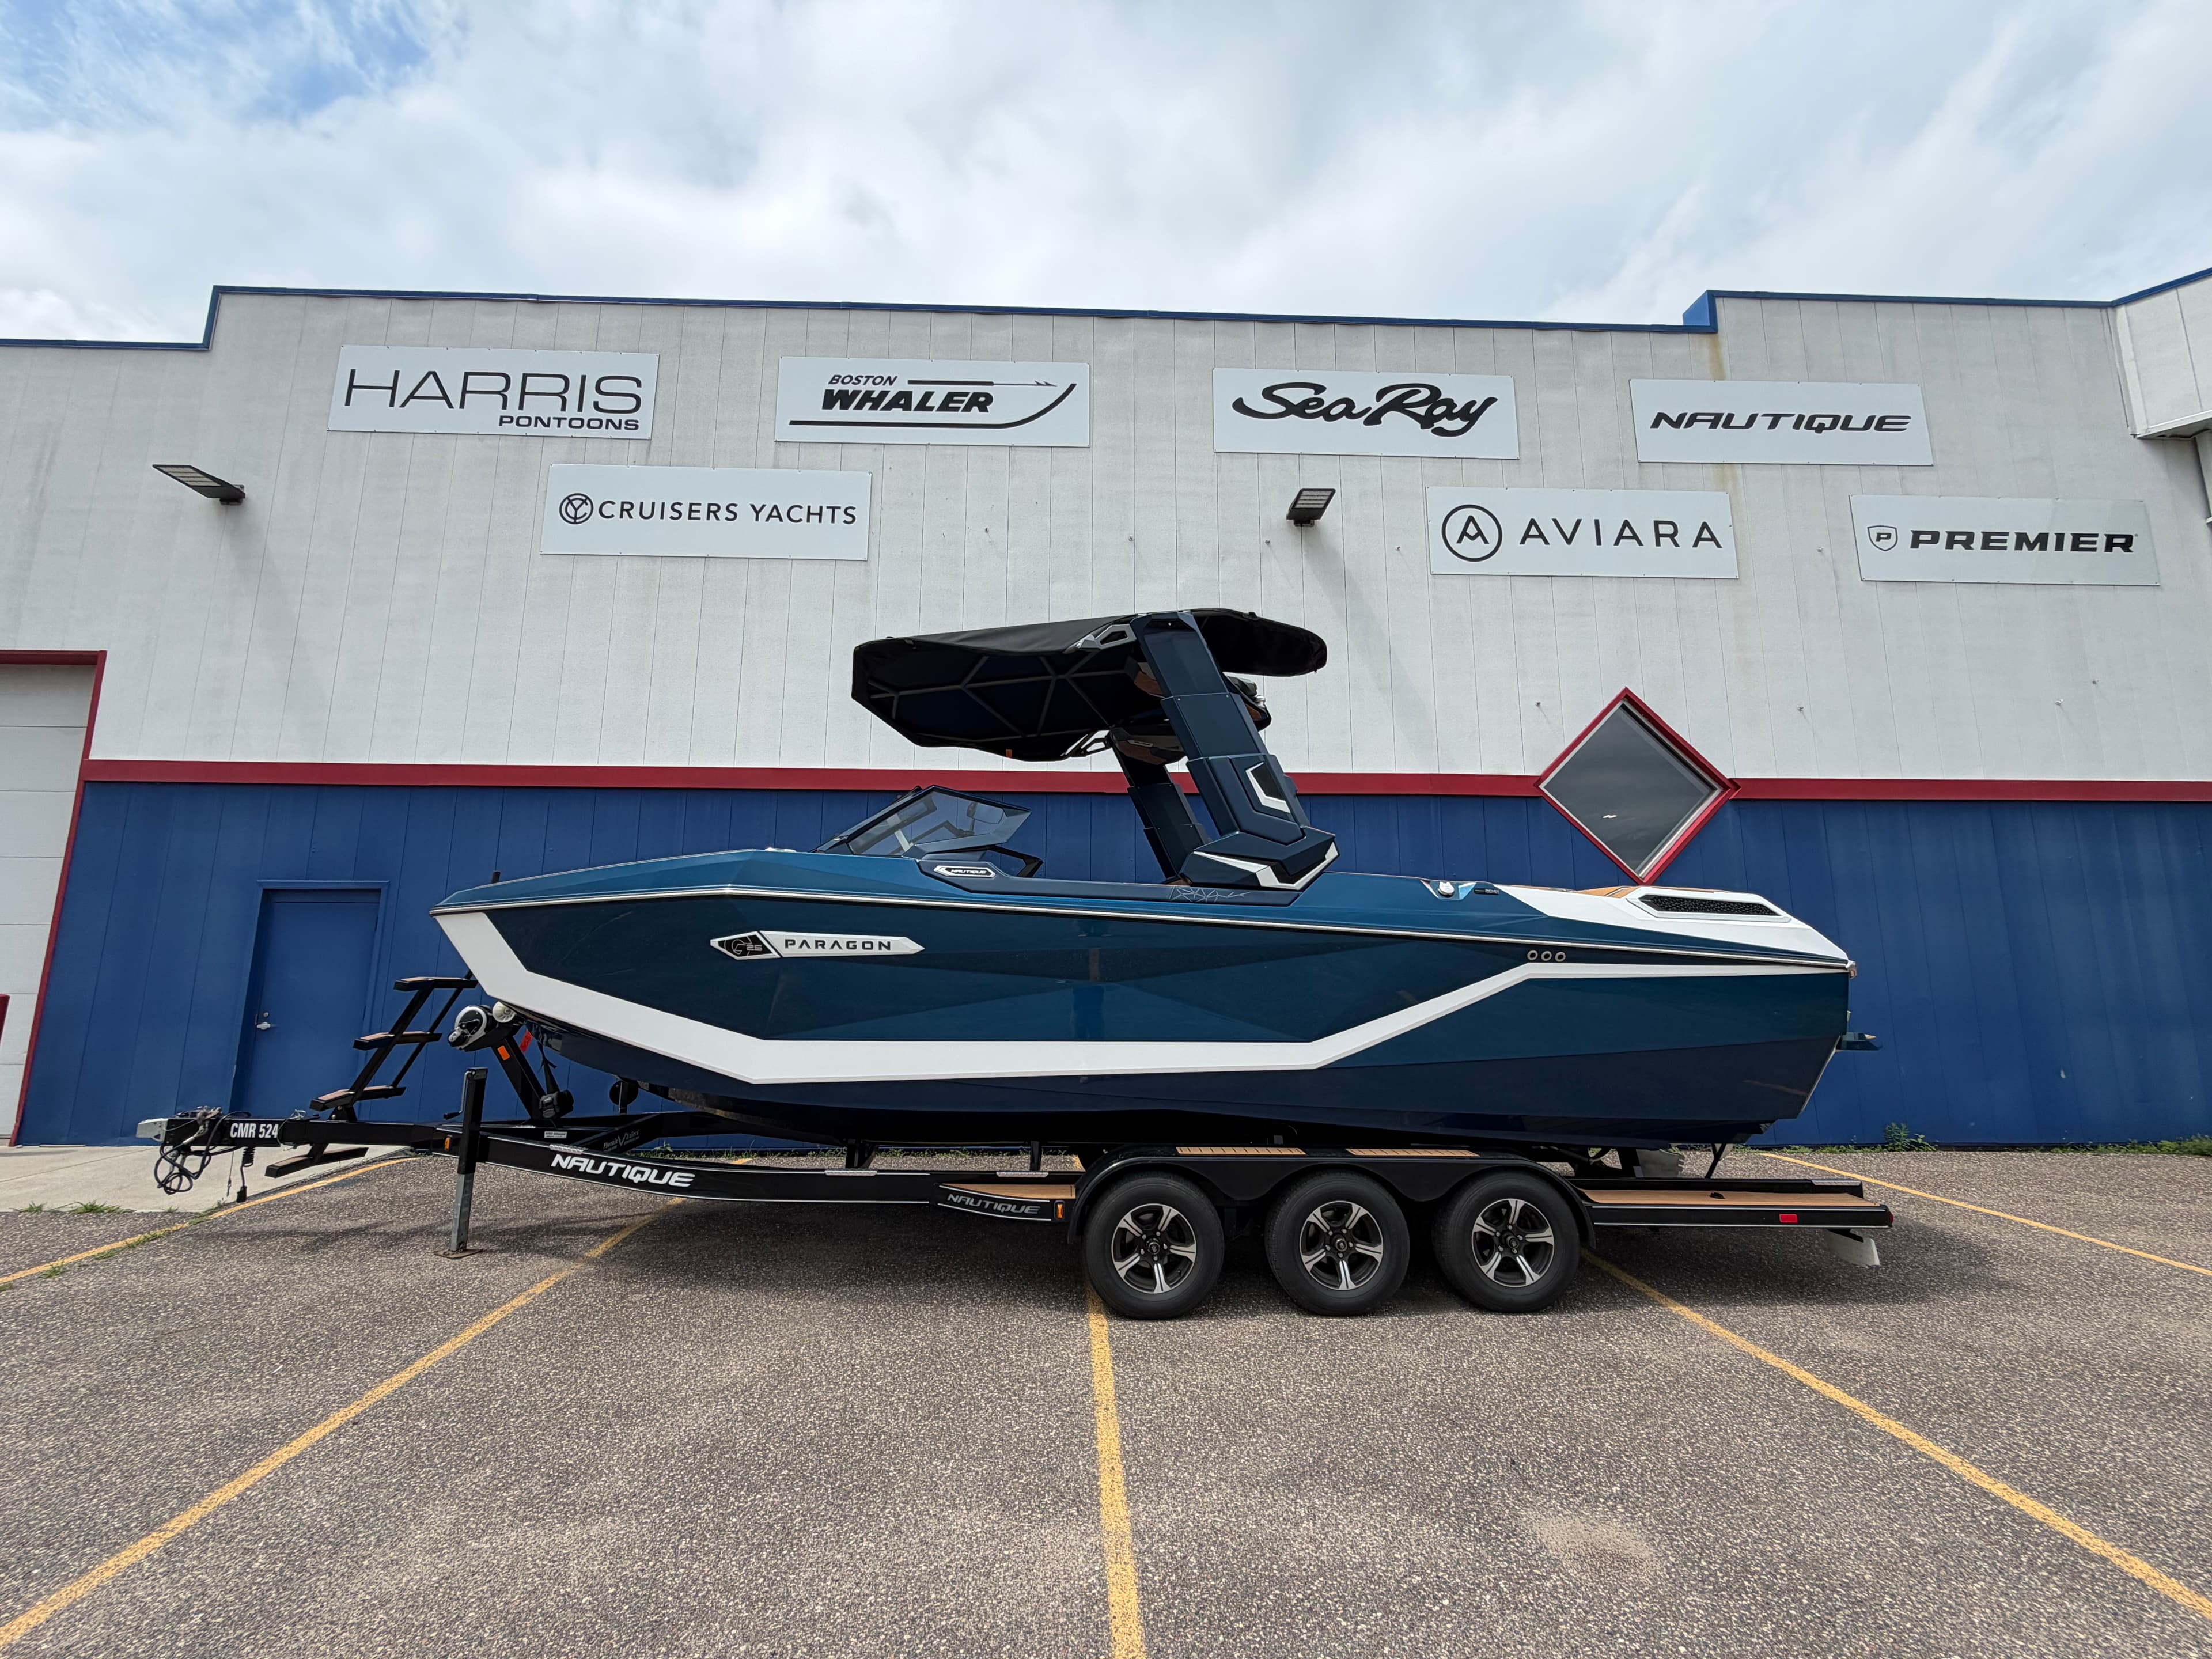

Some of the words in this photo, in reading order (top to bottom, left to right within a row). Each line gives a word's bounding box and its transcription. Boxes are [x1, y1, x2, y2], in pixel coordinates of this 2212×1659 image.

[344, 369, 642, 414] HARRIS
[828, 375, 898, 386] BOSTON
[821, 389, 994, 413] WHALER
[1232, 382, 1372, 422] Sea
[1363, 382, 1498, 437] Ray
[499, 415, 639, 431] PONTOONS
[1650, 412, 1911, 434] NAUTIQUE
[598, 500, 738, 521] CRUISERS
[749, 503, 856, 525] YACHTS
[1519, 518, 1722, 548] AVIARA
[1910, 529, 2134, 553] PREMIER
[785, 939, 891, 950] PARAGON
[230, 1123, 256, 1138] CMR
[259, 1124, 279, 1138] 524
[551, 1153, 696, 1187] NAUTIQUE
[947, 1193, 1041, 1214] NAUTIQUE
